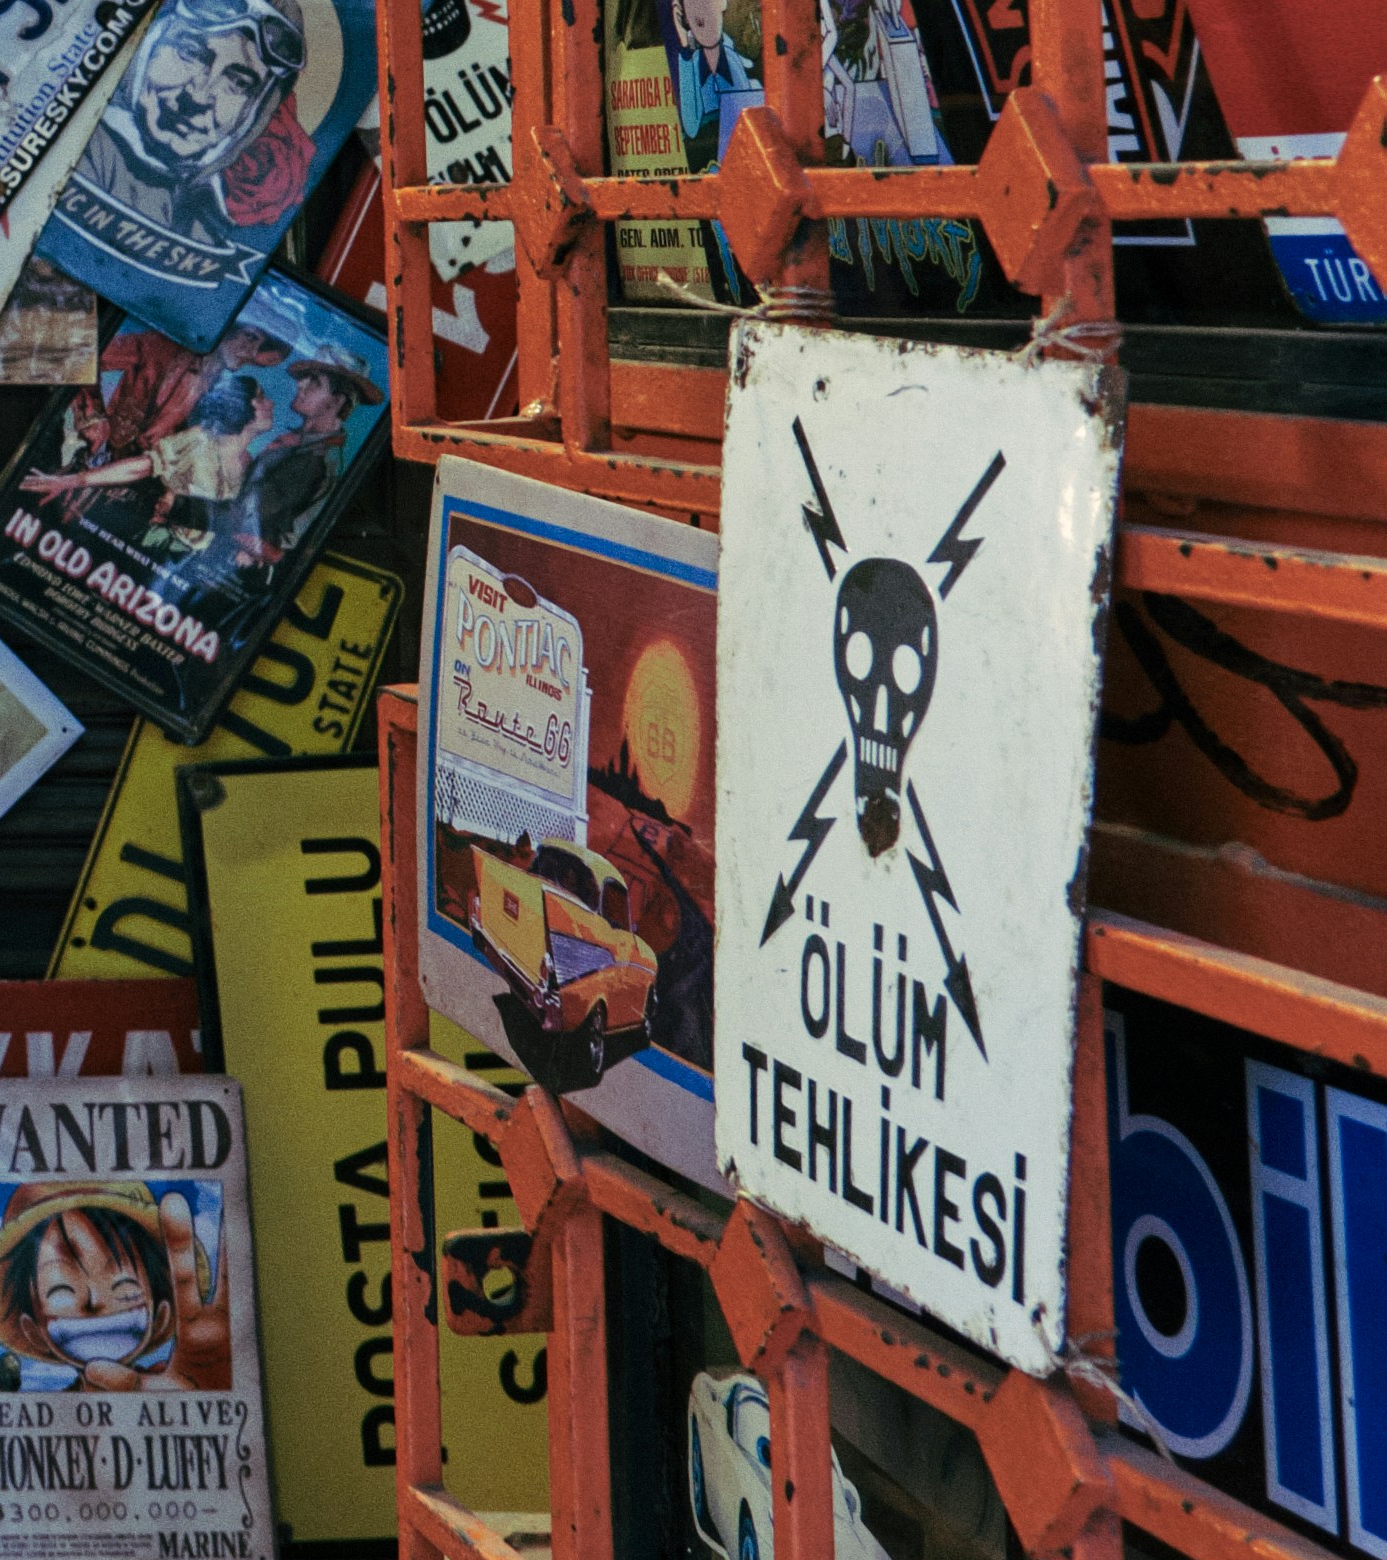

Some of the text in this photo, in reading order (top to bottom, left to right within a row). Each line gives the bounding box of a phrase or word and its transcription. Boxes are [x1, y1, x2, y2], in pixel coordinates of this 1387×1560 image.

[45, 17, 100, 82] State
[611, 77, 661, 110] SARATOGA
[614, 123, 670, 157] SEPTEMBER
[81, 202, 116, 234] IN
[111, 217, 171, 264] THE
[163, 240, 221, 288] SKY
[650, 227, 685, 249] ADM.
[1304, 247, 1387, 303] TÜR
[2, 506, 46, 550] IN
[32, 526, 97, 582] OLD
[78, 554, 233, 665] ARIZONA
[468, 574, 508, 614] VISIT
[454, 659, 472, 676] ON
[456, 587, 572, 692] PONTIAC
[313, 637, 374, 739] STATE
[453, 675, 544, 754] Route
[543, 712, 572, 770] 66
[799, 897, 947, 1100] ÖLÜM
[741, 1042, 1027, 1306] TEHLİKESİ
[76, 1401, 114, 1427] OR
[137, 1399, 235, 1427] ALIVE
[157, 1530, 253, 1560] MARINE
